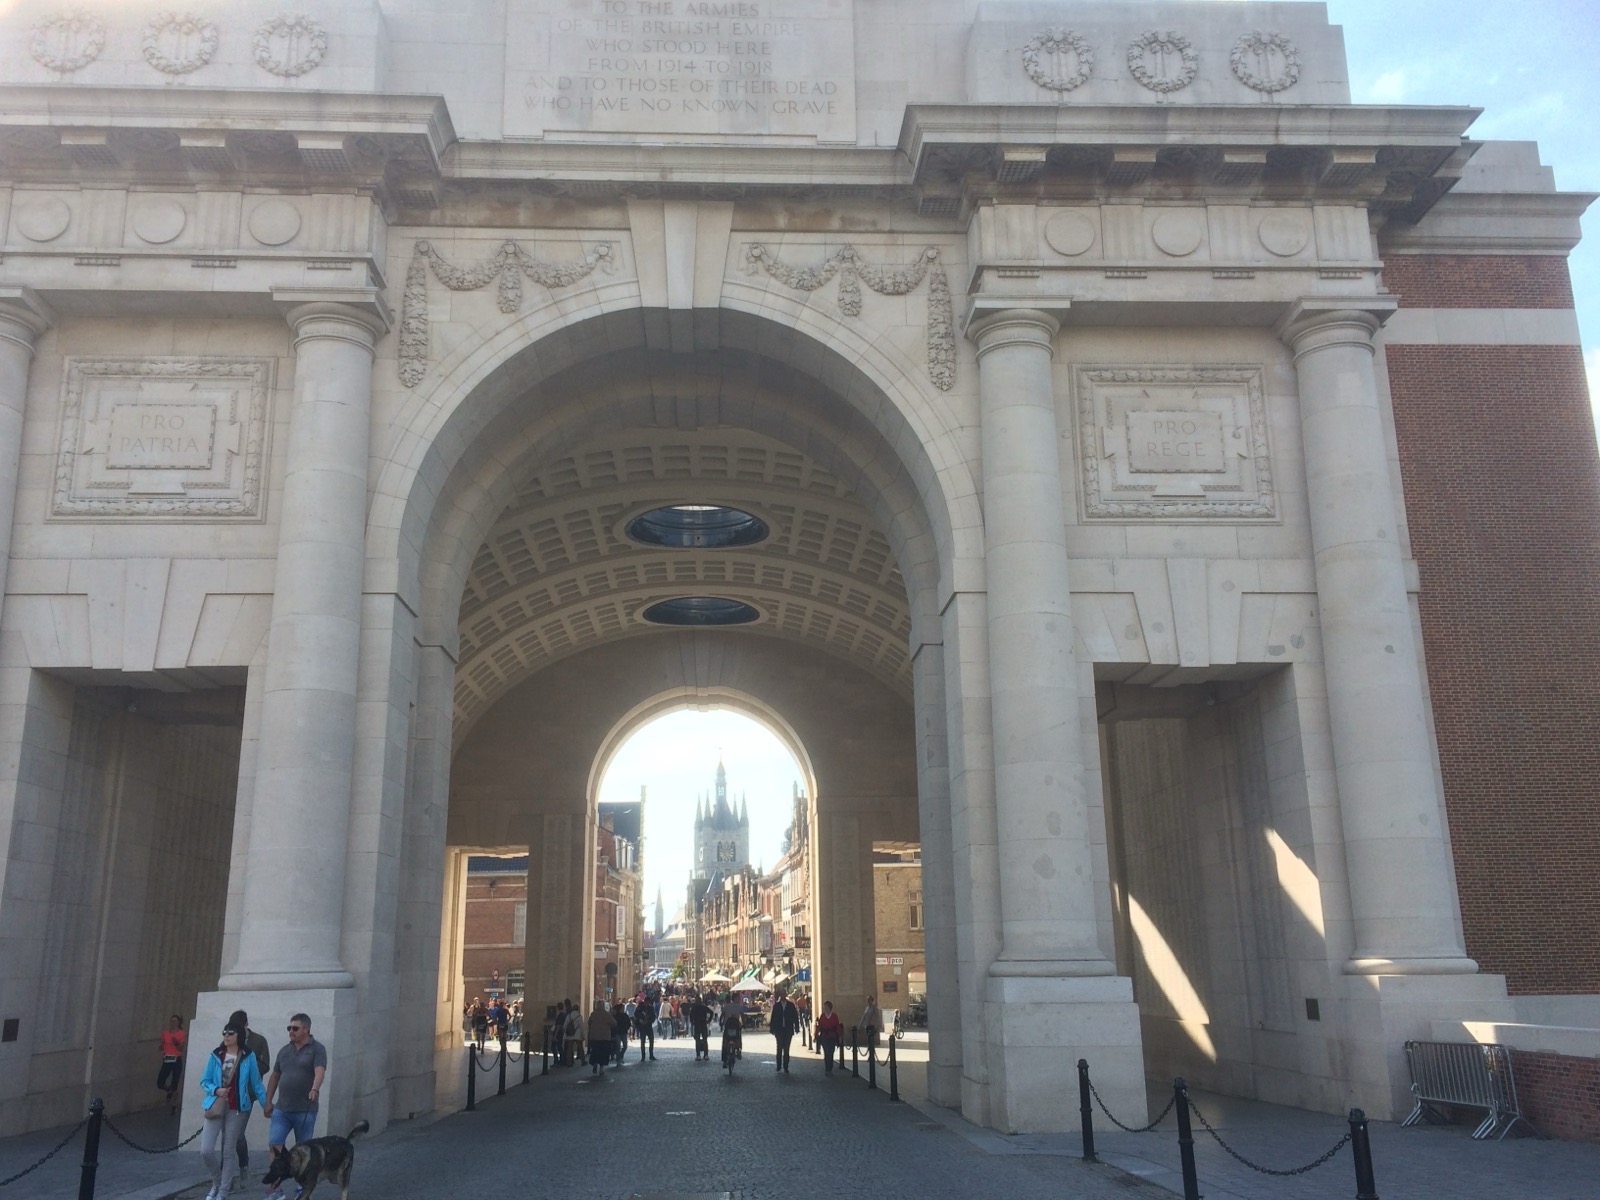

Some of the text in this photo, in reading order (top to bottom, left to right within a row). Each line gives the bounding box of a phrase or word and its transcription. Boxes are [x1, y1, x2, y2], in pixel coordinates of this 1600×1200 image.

[602, 0, 760, 17] TO THE ARMIES
[558, 18, 803, 37] OF THE BRITISH EMPIRE
[585, 38, 772, 56] WHO STOOD HERE
[588, 57, 773, 75] FROM 1914 TO 1918
[524, 75, 838, 95] AND TO THOSE OF THEIR DEAD
[523, 95, 838, 115] WHO HAVE NO KNOWN GRAVE
[140, 414, 185, 430] PRO
[1153, 420, 1197, 435] PRO
[119, 436, 199, 453] PATRIA
[1146, 441, 1206, 457] REGE
